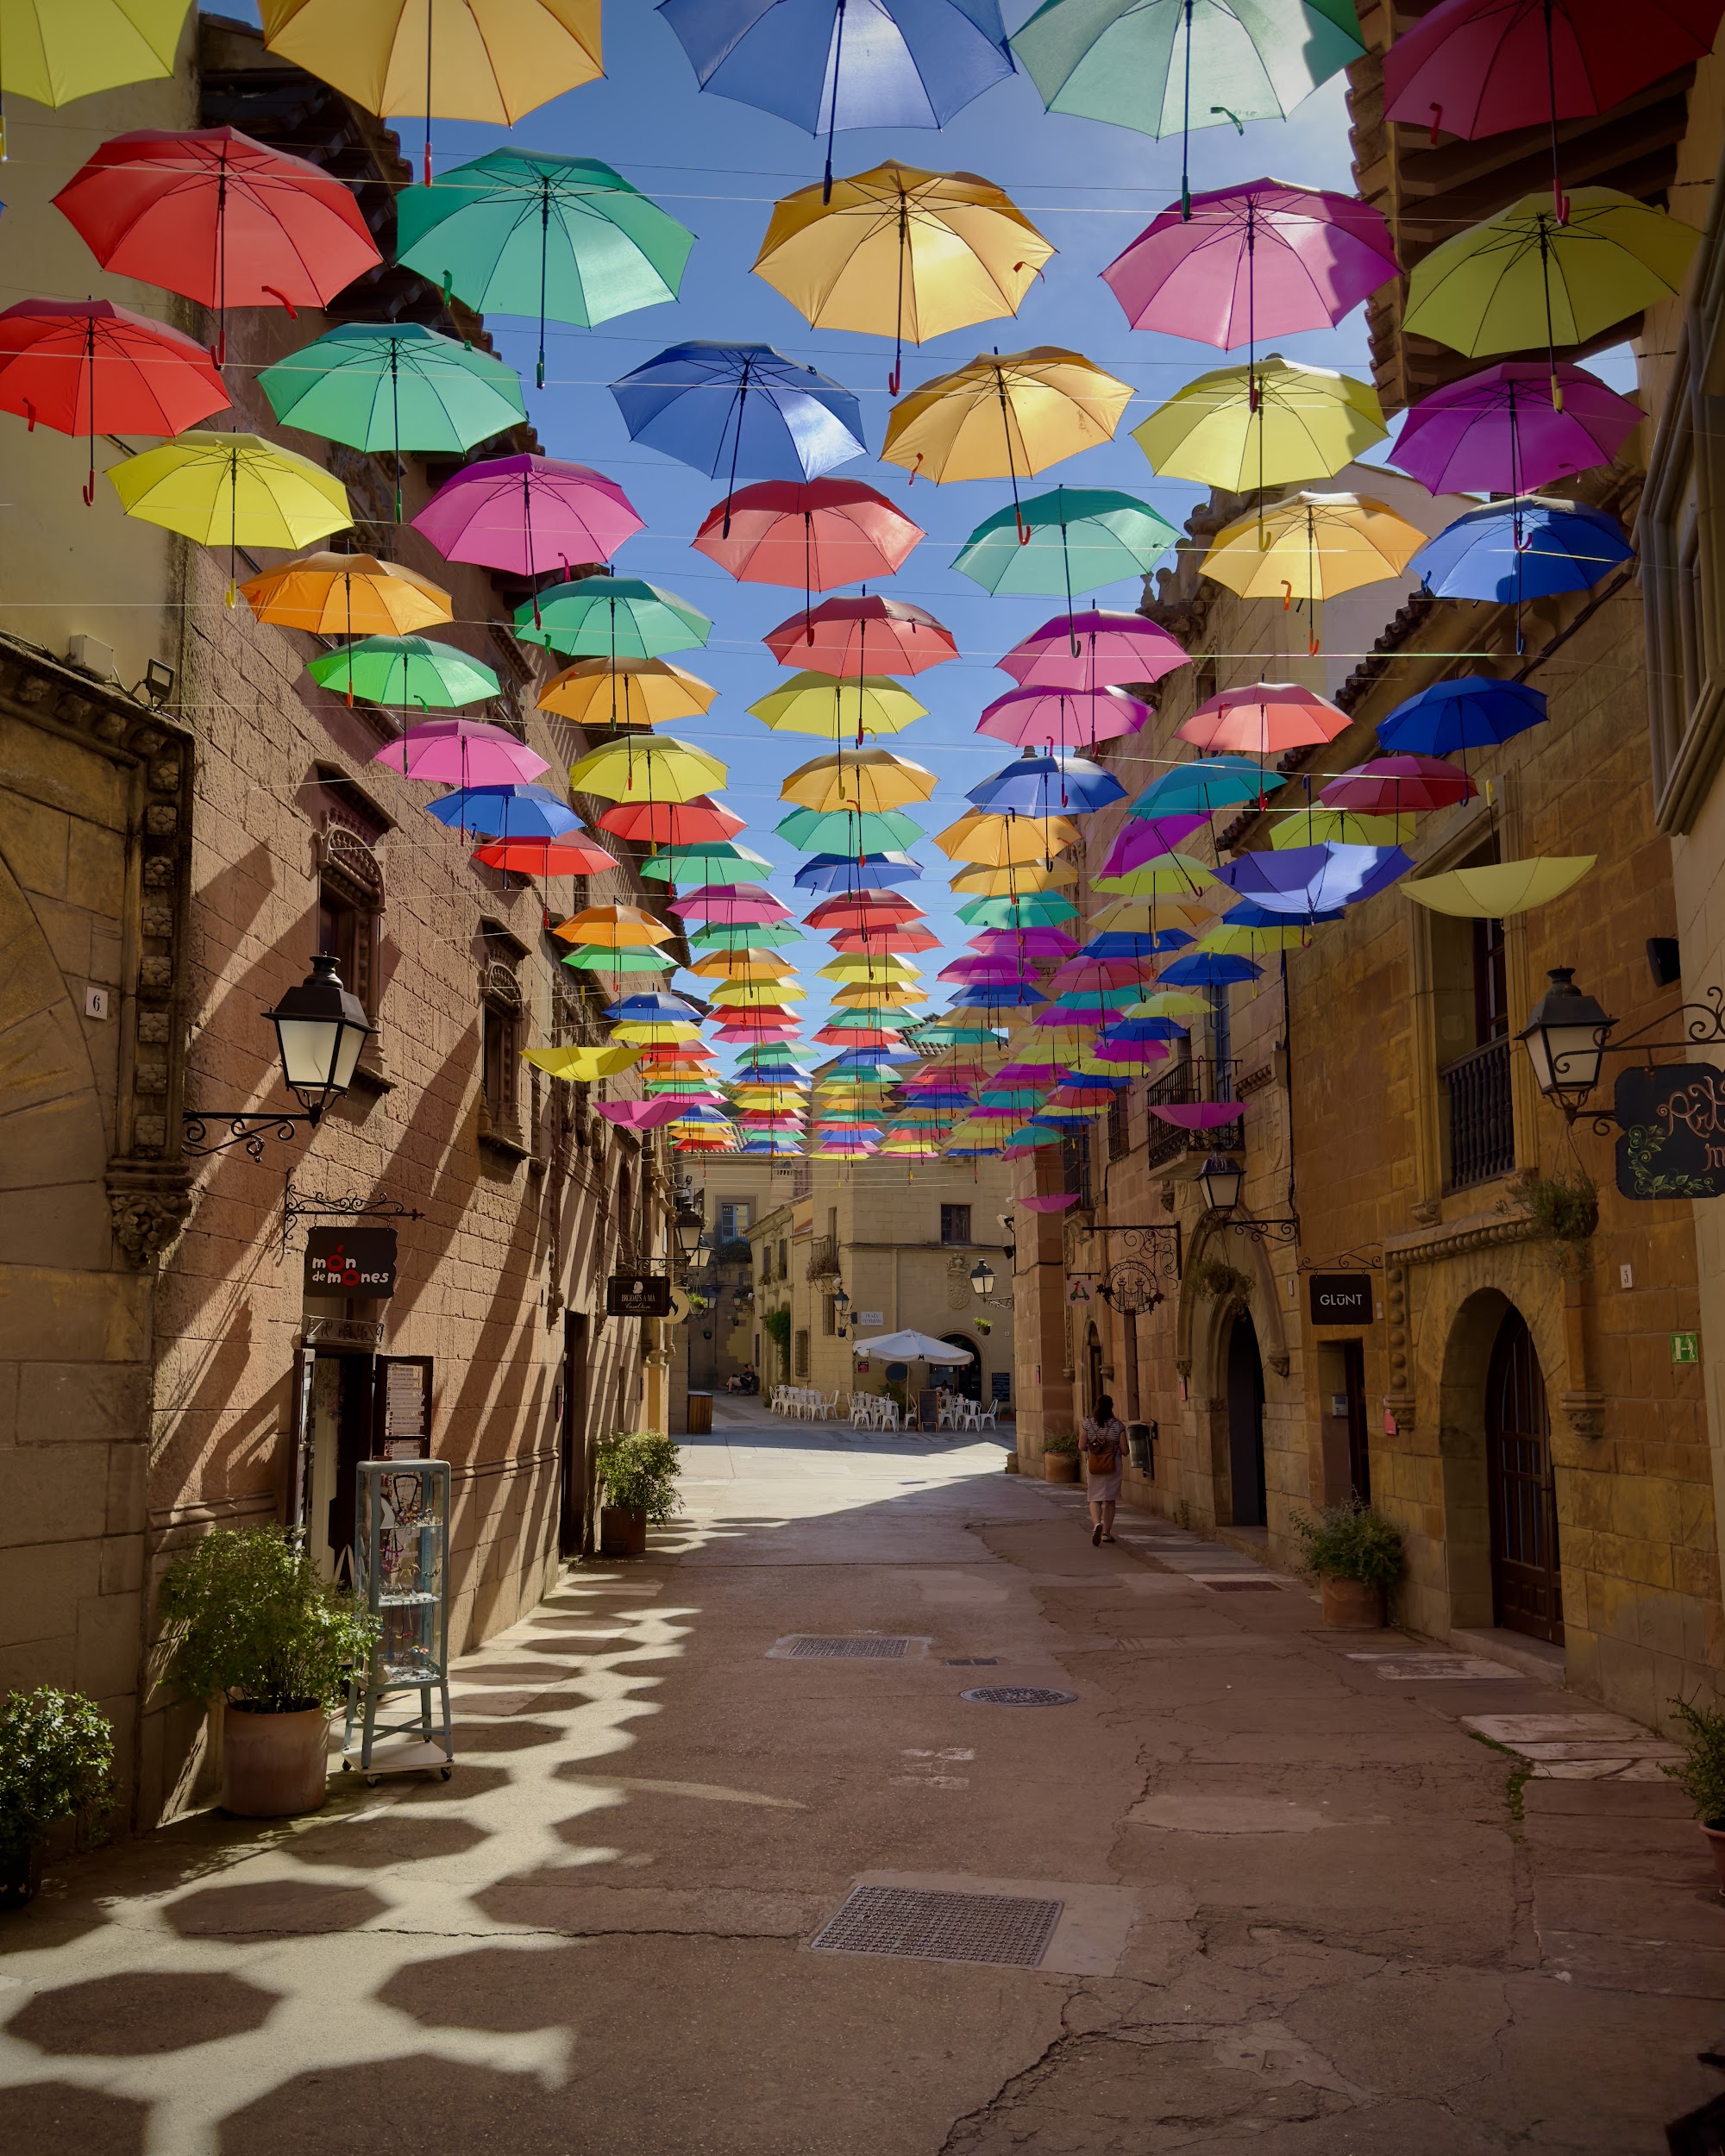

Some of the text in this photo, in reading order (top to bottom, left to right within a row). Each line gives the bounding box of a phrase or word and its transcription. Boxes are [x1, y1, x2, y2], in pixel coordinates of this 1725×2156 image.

[312, 1244, 357, 1272] món
[311, 1269, 390, 1287] de mones
[621, 1294, 643, 1302] BRODATS
